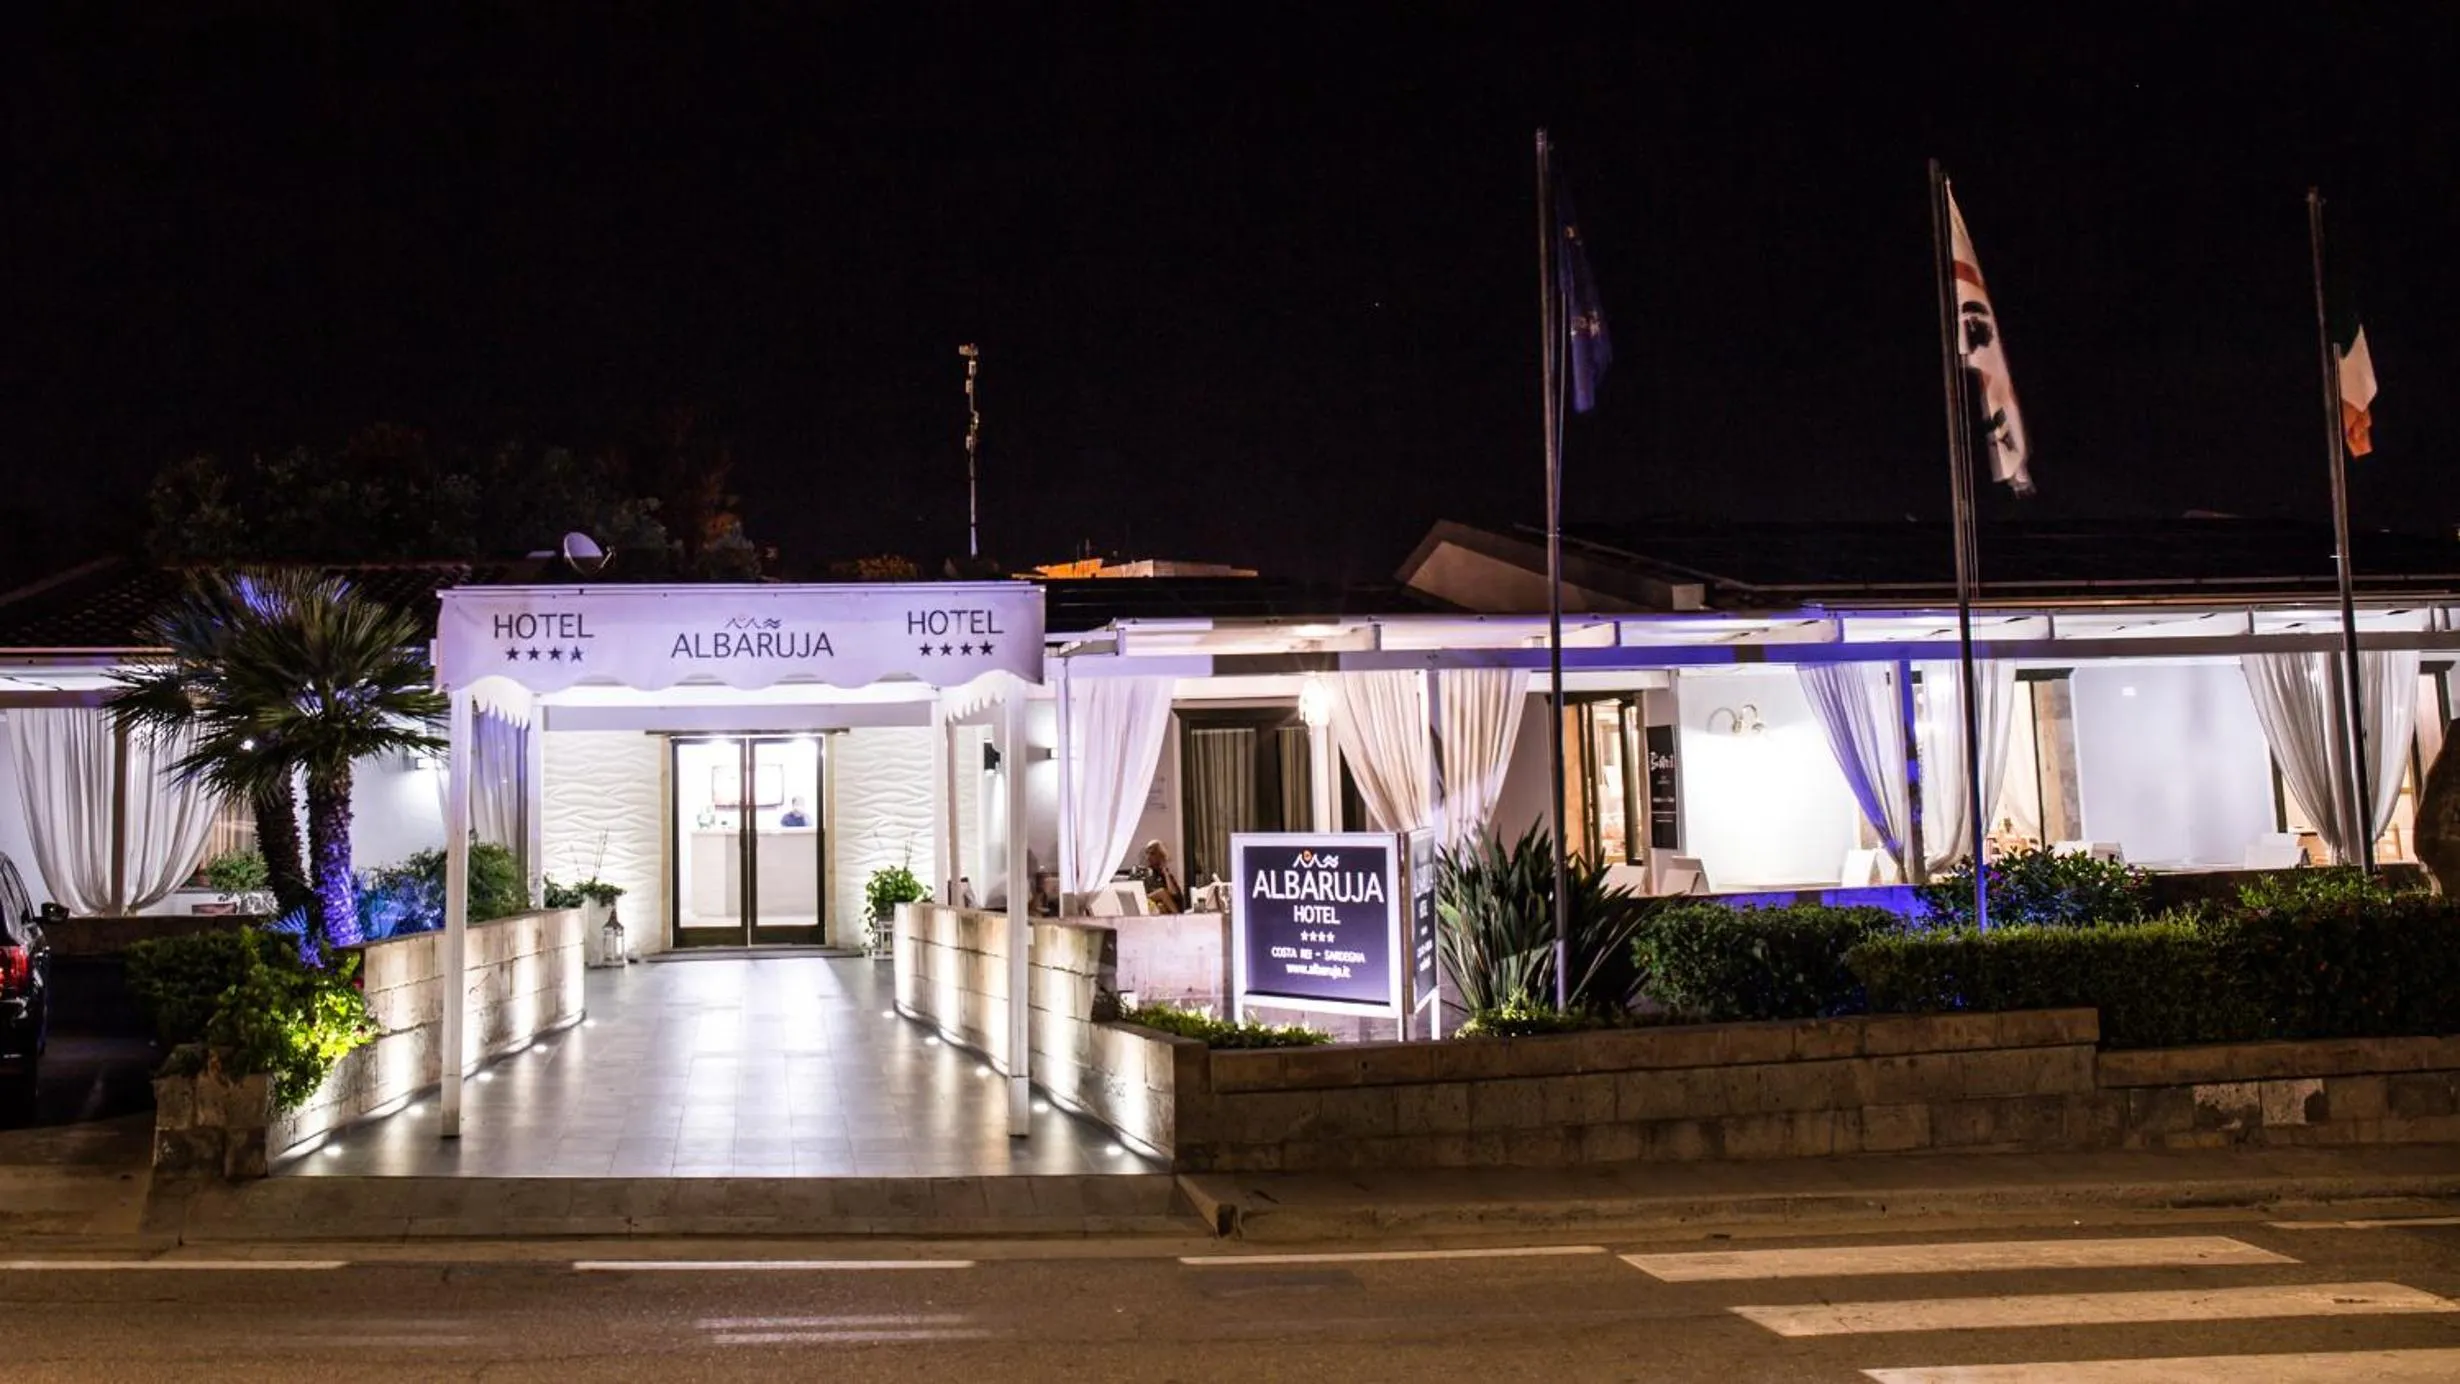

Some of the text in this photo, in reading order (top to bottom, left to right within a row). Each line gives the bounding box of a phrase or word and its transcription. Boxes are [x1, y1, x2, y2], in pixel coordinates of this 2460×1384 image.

[494, 612, 594, 639] HOTEL
[907, 609, 1005, 635] HOTEL
[671, 632, 834, 658] ALBARUJA
[1252, 869, 1385, 904] ALBARUJA
[1293, 905, 1341, 925] HOTEL
[1271, 946, 1298, 959] COSTA
[1324, 949, 1367, 963] SARDEGNA
